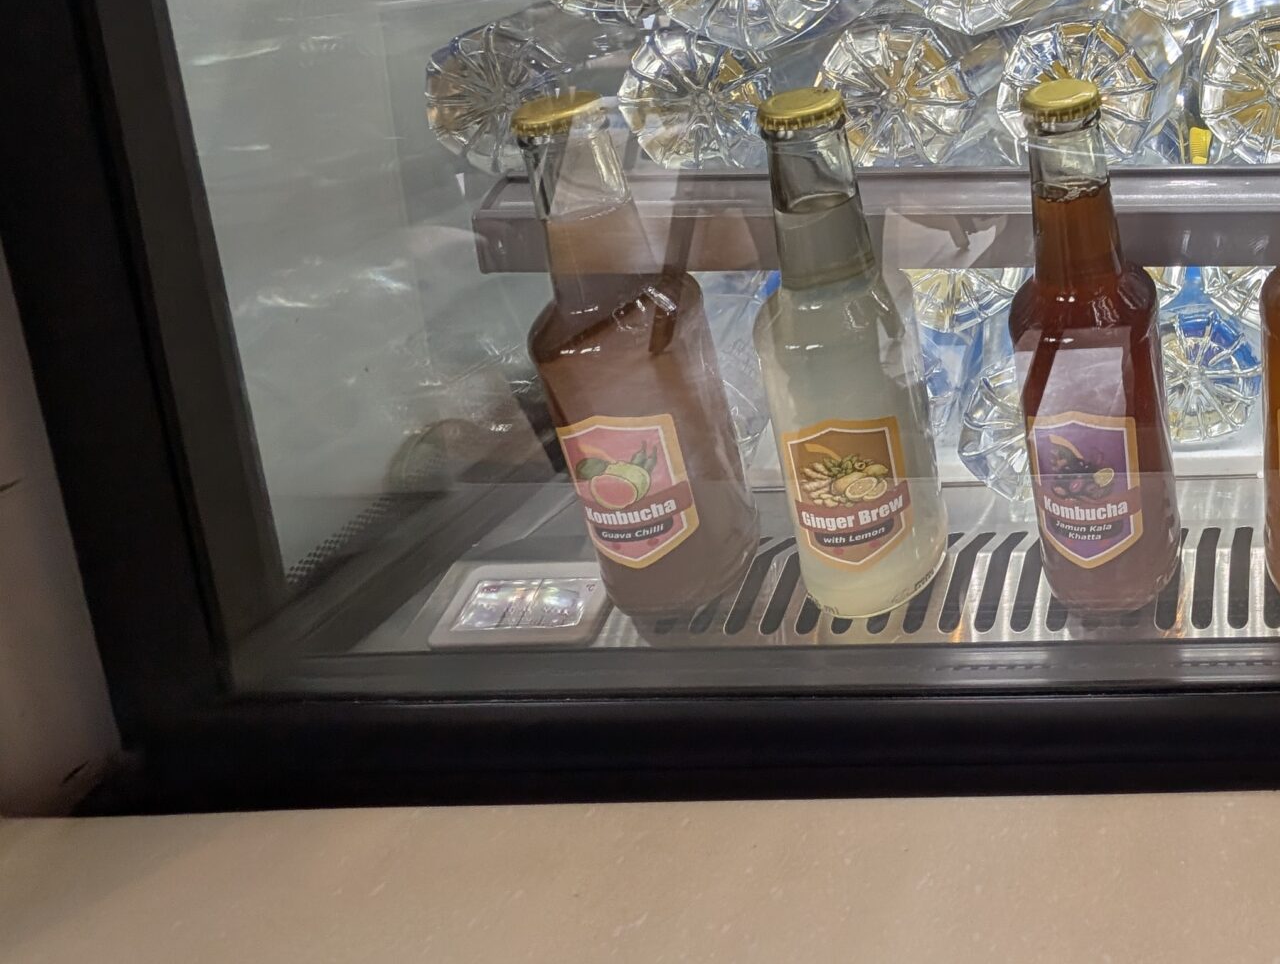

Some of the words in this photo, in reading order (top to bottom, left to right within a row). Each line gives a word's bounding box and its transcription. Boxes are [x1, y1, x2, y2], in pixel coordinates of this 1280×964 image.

[584, 497, 676, 527] Kombucha
[801, 506, 857, 531] Ginger
[857, 494, 904, 525] Brew
[1043, 494, 1128, 522] Kombucha
[601, 528, 632, 540] Guava
[634, 524, 664, 537] Chilli
[822, 534, 847, 544] with
[848, 525, 886, 543] Lemon
[1068, 531, 1102, 541] Khatta
[1088, 522, 1113, 533] Kala
